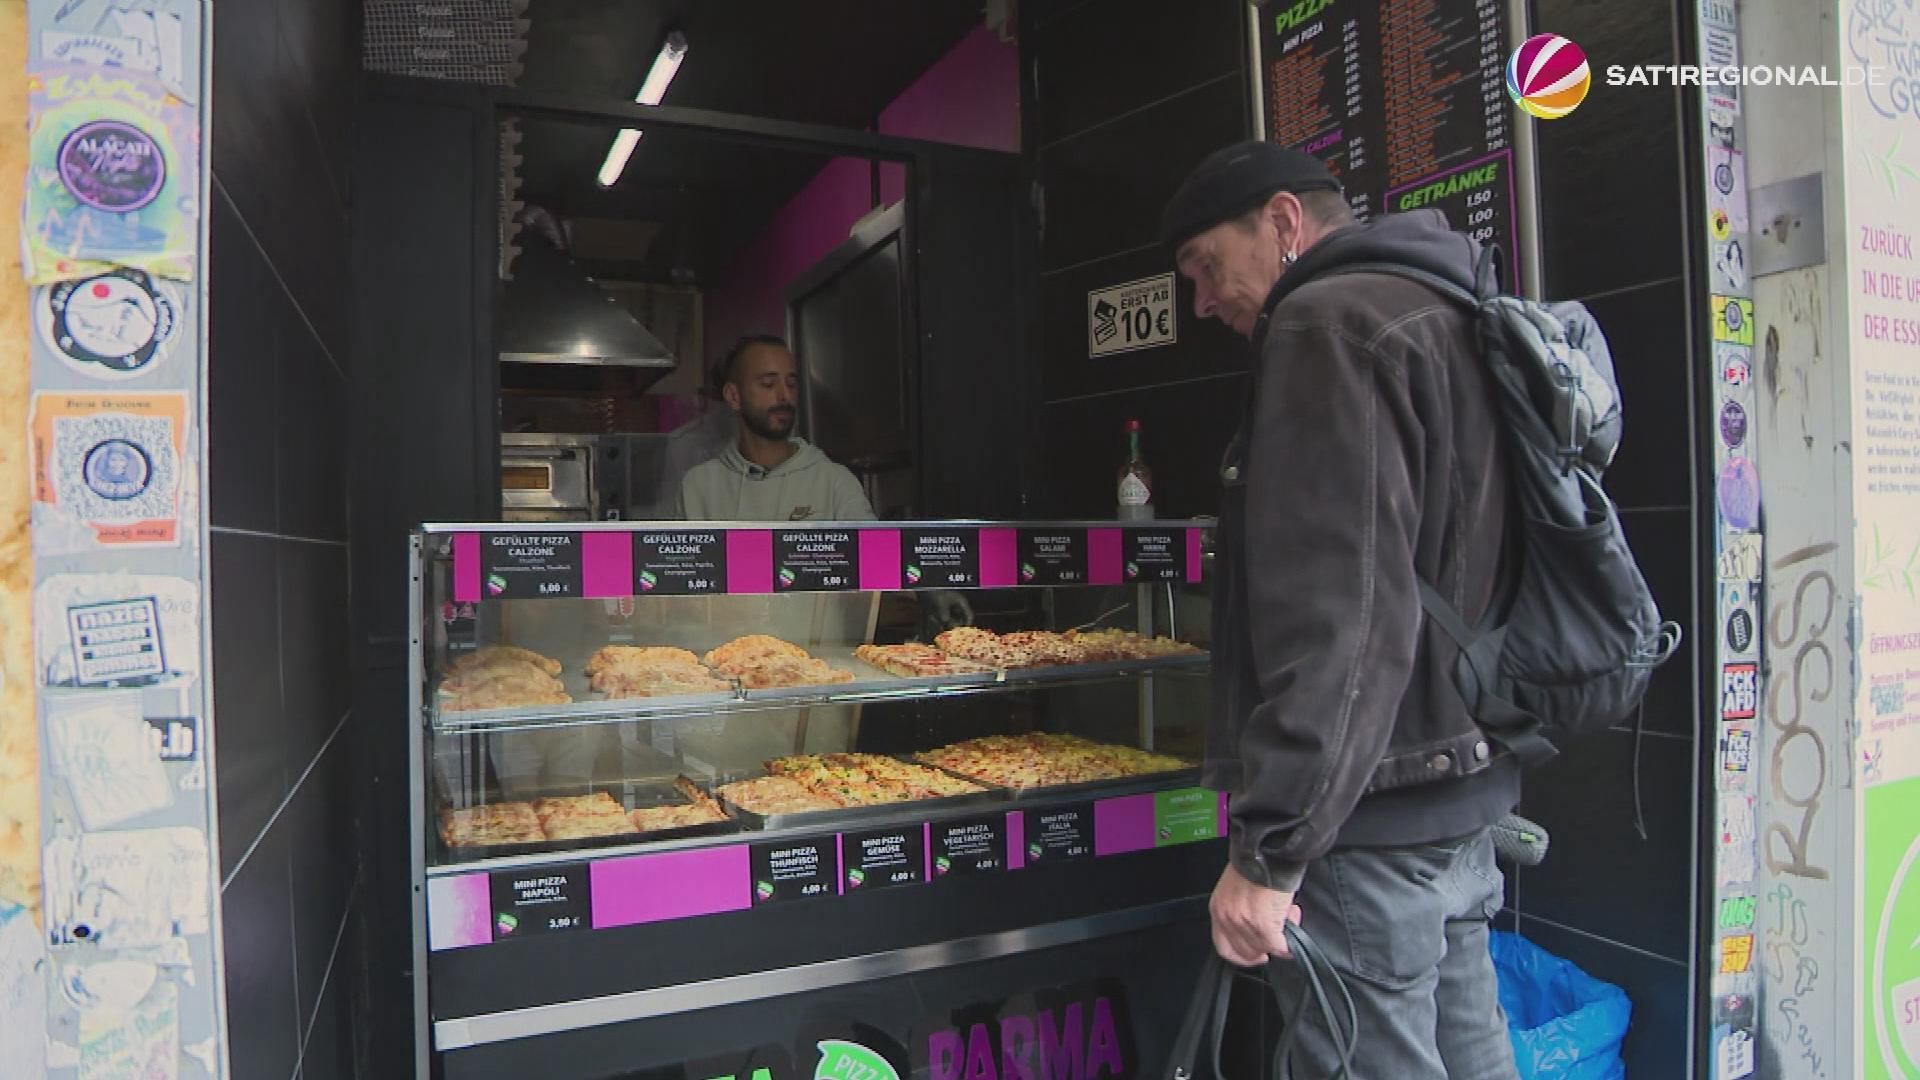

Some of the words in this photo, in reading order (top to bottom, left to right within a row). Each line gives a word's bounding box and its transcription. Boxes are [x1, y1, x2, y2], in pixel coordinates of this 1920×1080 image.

[1400, 163, 1499, 211] GETRÄNKE
[1862, 224, 1912, 260] ZURÜCK
[1863, 268, 1877, 296] IN
[1881, 272, 1903, 299] DIE
[1121, 294, 1149, 310] ERST
[1153, 290, 1169, 303] AB
[1864, 314, 1890, 341] DER
[1894, 319, 1920, 345] ESS
[492, 535, 540, 546] GEFÜLLTE
[542, 536, 571, 546] PIZZA
[643, 533, 688, 543] GEFÜLLTE
[690, 534, 716, 543] PIZZA
[783, 533, 823, 542] GEFÜLLTE
[825, 534, 849, 542] PIZZA
[919, 536, 938, 544] MINI
[939, 536, 961, 544] PIZZA
[508, 547, 555, 556] CALZONE
[658, 545, 702, 554] CALZONE
[796, 544, 836, 552] CALZONE
[914, 546, 967, 554] MOZZARELLA
[1724, 671, 1755, 692] FCK
[967, 824, 990, 834] PIZZA
[862, 838, 881, 848] MINI
[882, 834, 905, 845] PIZZA
[943, 832, 995, 846] VEGETARISCH
[770, 850, 791, 860] MINI
[792, 846, 817, 857] PIZZA
[867, 844, 901, 856] GEMÜSE
[769, 854, 819, 868] THUNFISCH
[514, 880, 537, 890] MINI
[538, 876, 568, 888] PIZZA
[522, 887, 560, 899] NAPOLI
[929, 997, 1122, 1080] PARMA
[834, 1054, 889, 1080] PIZZ
